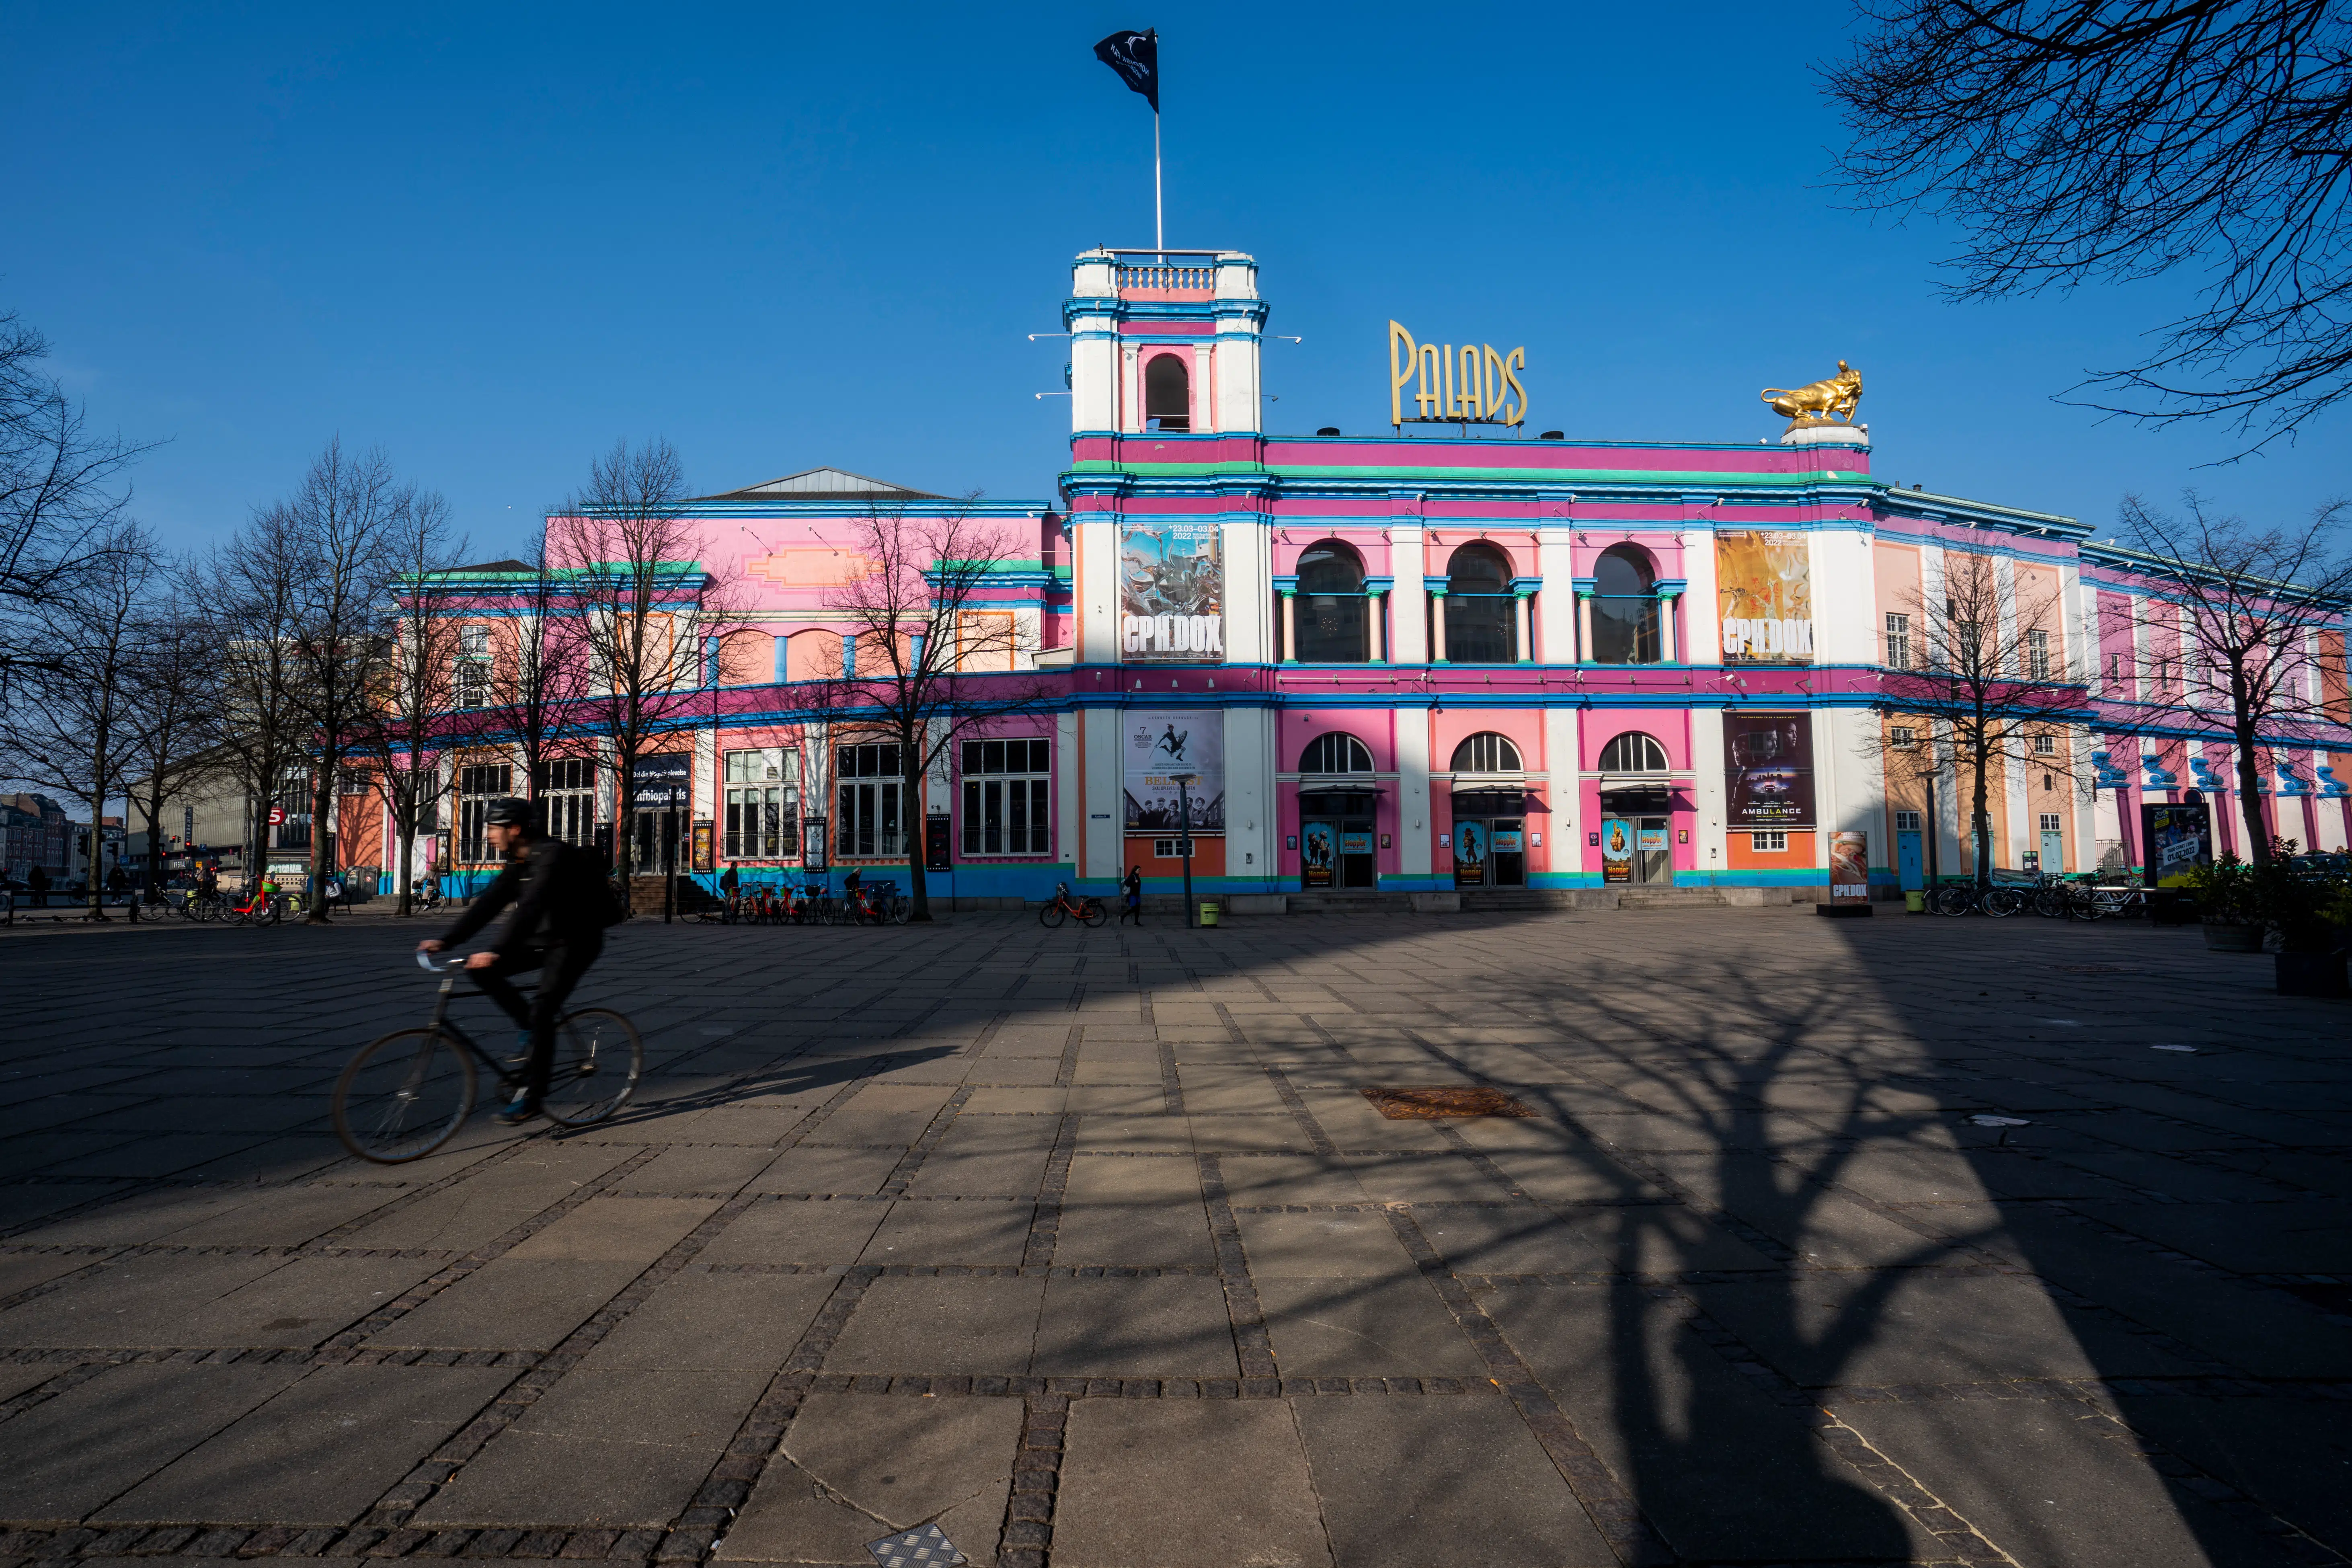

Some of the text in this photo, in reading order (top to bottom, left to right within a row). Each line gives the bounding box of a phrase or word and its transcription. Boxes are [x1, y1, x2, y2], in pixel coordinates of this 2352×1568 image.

[1389, 319, 1528, 429] PALADS
[1123, 615, 1221, 652] CPH:DOX
[1723, 618, 1812, 654] CPH:DOX
[1140, 727, 1147, 735] 7
[1144, 776, 1203, 785] BELFST
[633, 788, 686, 804] nfbiopalds
[269, 810, 280, 823] S
[1344, 839, 1367, 848] Hopper
[1642, 836, 1662, 845] Hopper
[2167, 846, 2195, 862] 01.07.2022
